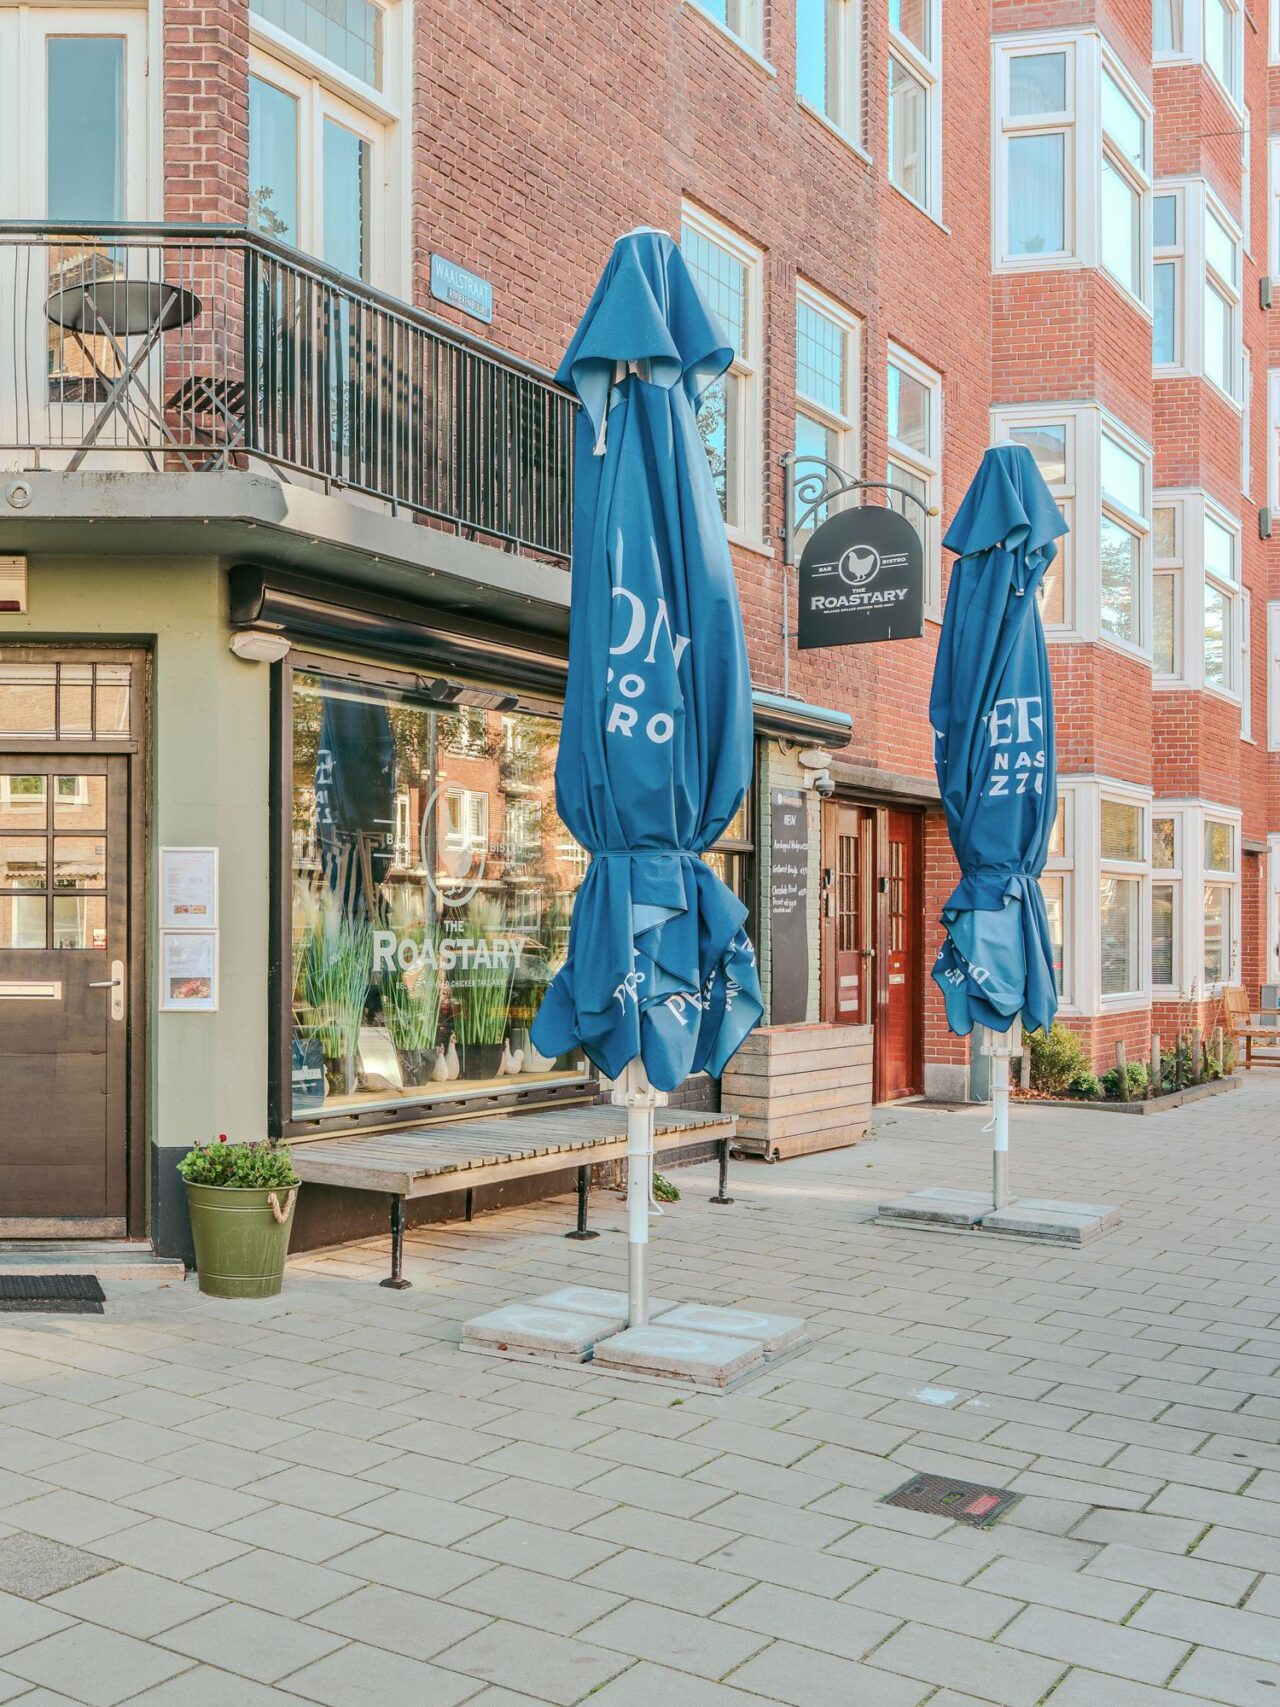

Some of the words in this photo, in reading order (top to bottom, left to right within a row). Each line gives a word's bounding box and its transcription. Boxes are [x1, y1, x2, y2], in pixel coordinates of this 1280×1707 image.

[435, 260, 489, 302] WAALSTRAAT
[810, 588, 908, 610] ROASTARY
[443, 920, 465, 932] THE
[372, 930, 525, 972] ROASTARY
